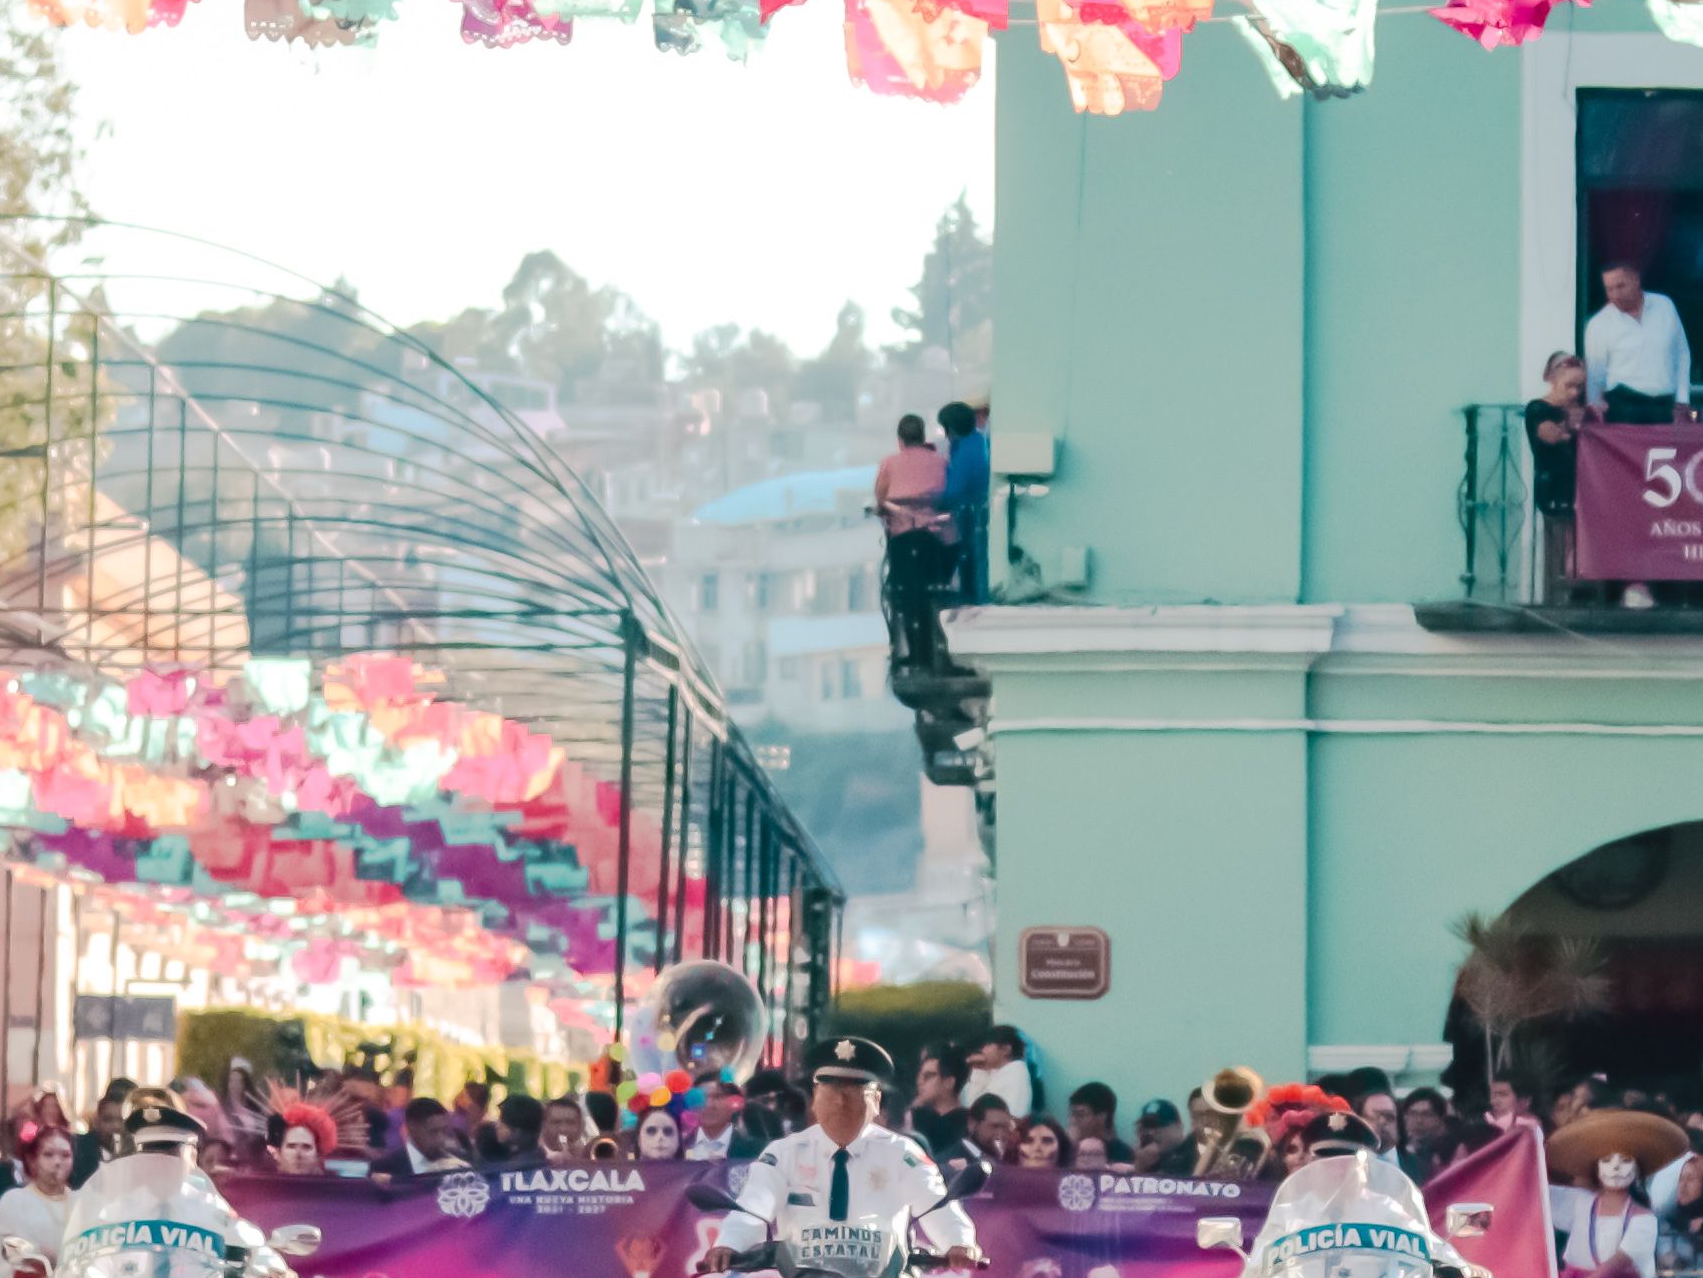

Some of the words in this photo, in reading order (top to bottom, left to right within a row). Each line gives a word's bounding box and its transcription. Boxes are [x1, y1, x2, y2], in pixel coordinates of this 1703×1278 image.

[1650, 519, 1702, 538] AÑOS
[500, 1169, 646, 1192] TLAXCALA
[1100, 1174, 1241, 1199] PATRONATO
[509, 1195, 532, 1204] UNA
[536, 1195, 574, 1204] NUEVA
[578, 1195, 634, 1204] HISTORIA
[161, 1225, 221, 1258] VIAL
[801, 1225, 882, 1243] CAMINOS
[801, 1244, 879, 1260] ESTATAL
[1266, 1224, 1362, 1272] POLICÍA
[1369, 1228, 1429, 1260] VIAL
